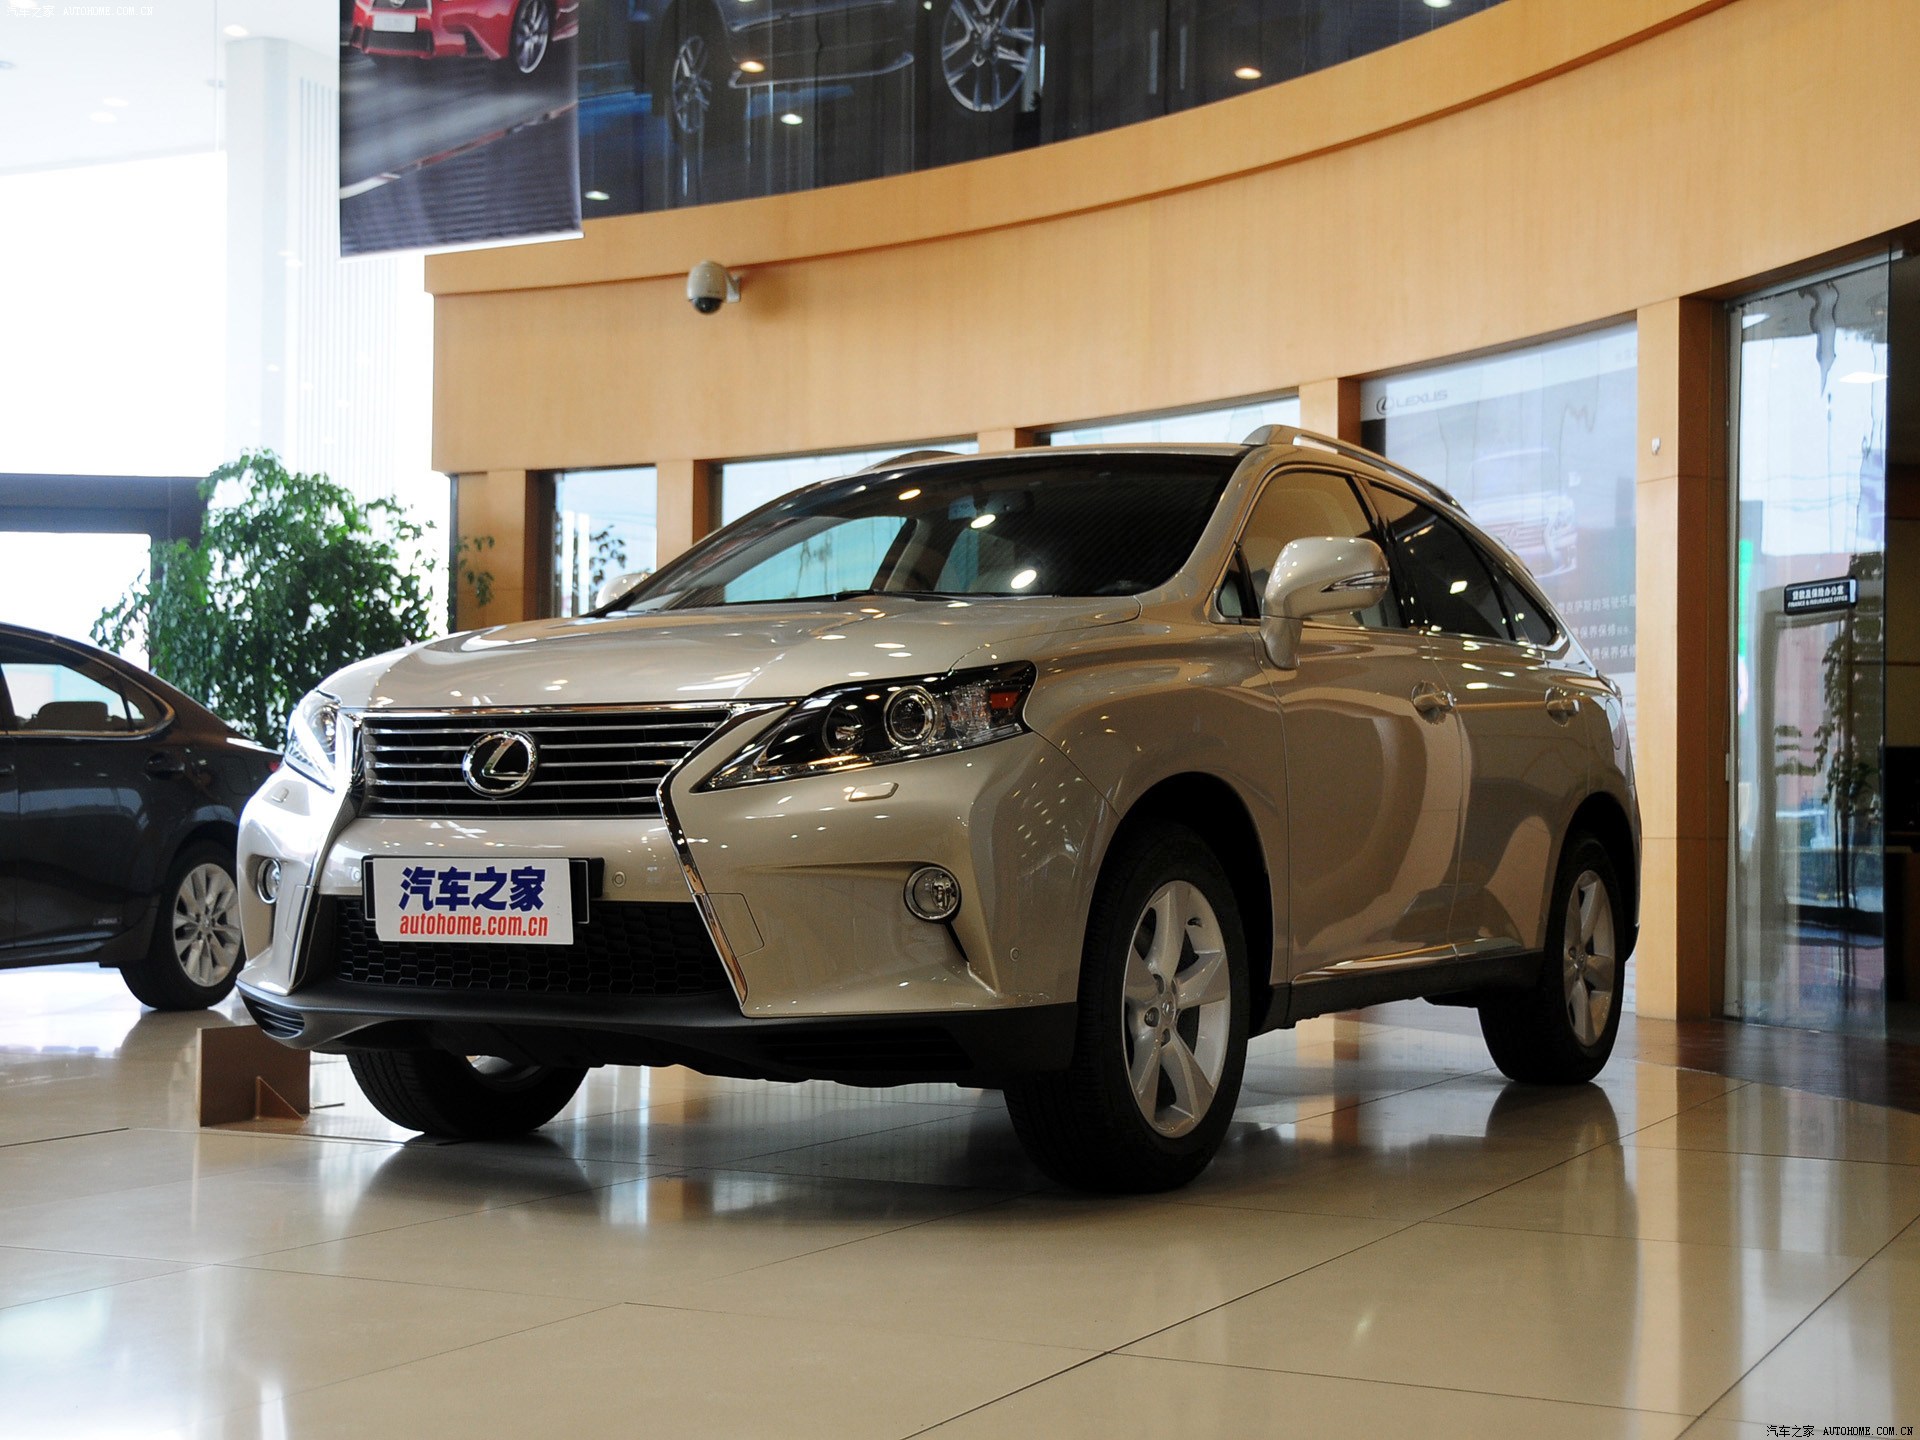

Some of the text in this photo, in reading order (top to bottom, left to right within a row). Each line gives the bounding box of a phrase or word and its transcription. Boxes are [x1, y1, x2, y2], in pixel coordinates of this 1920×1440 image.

[1396, 389, 1448, 408] LEXUS
[398, 866, 546, 912] 汽车之家
[400, 913, 549, 936] autohome.com.cn
